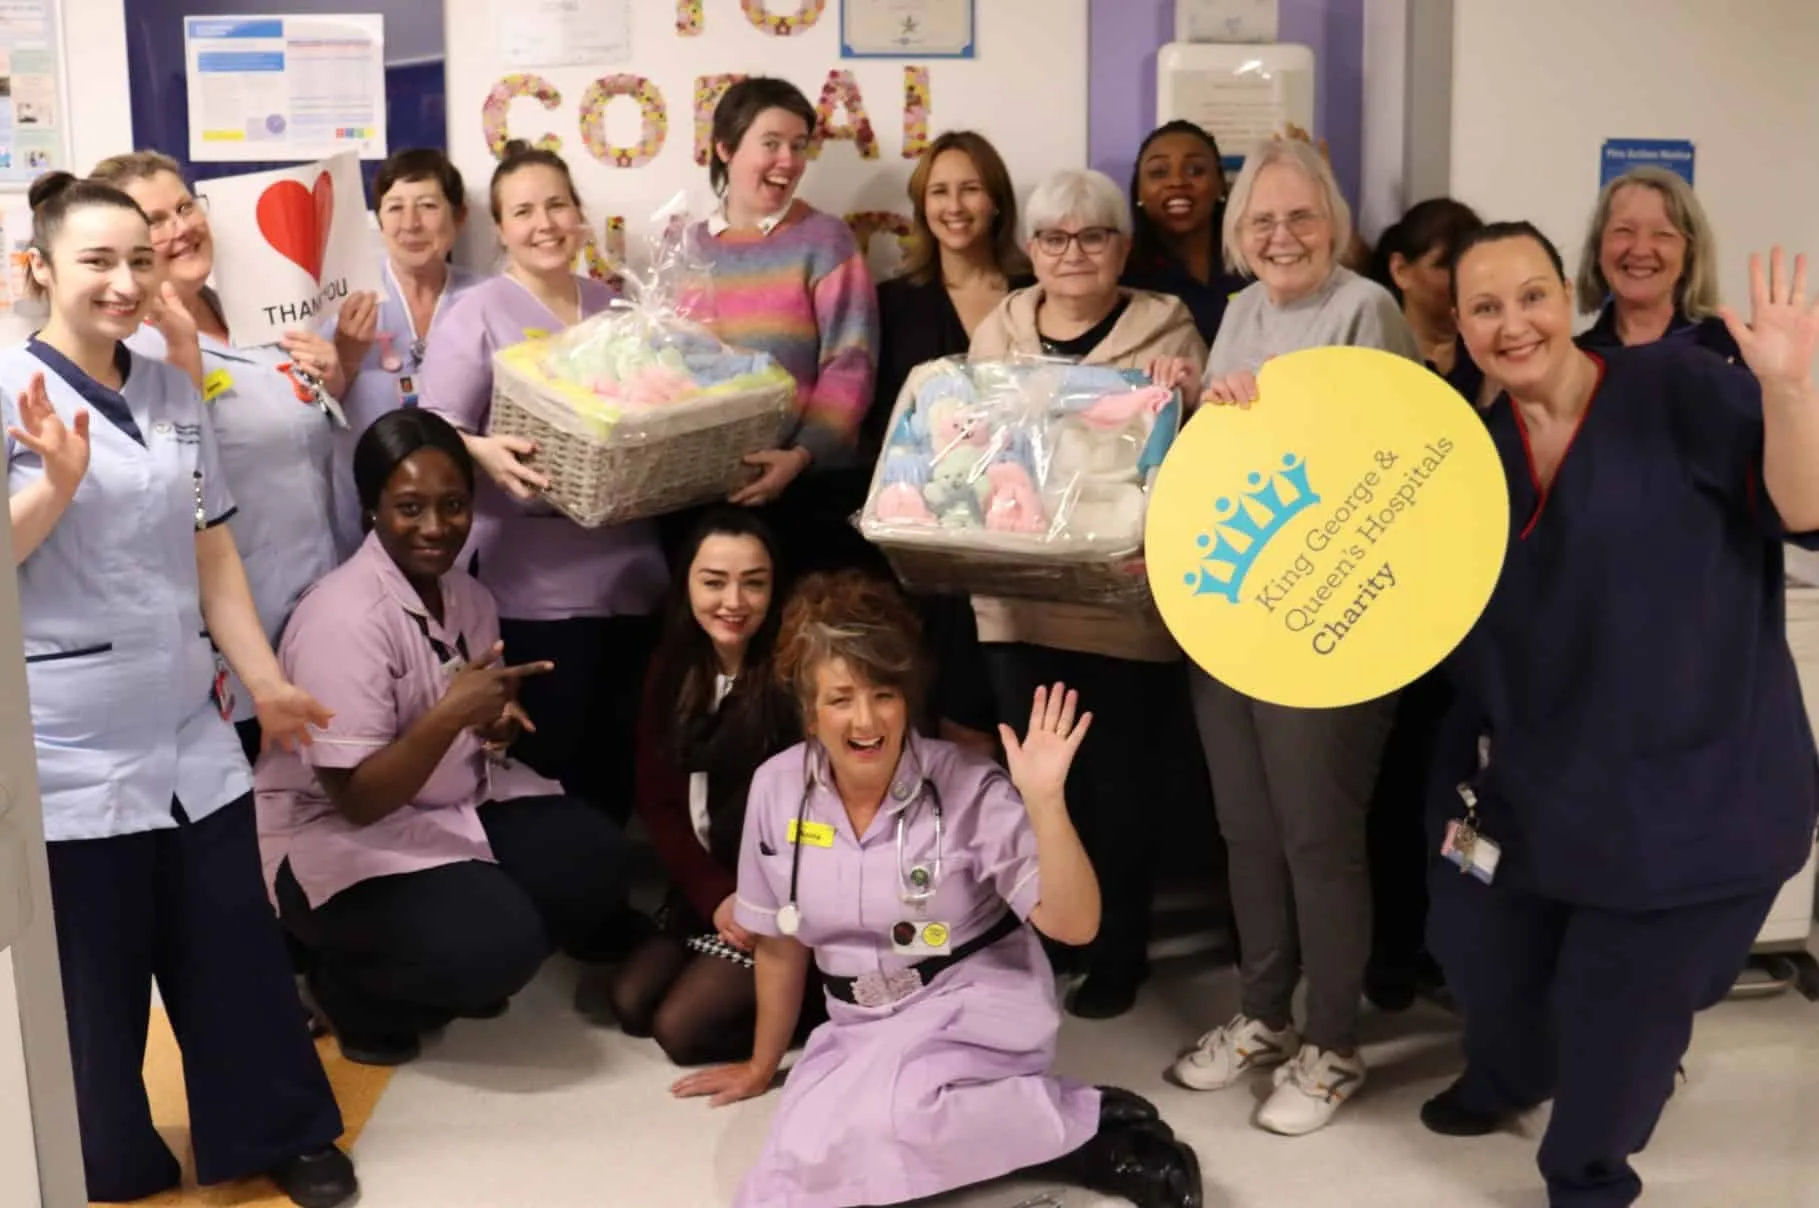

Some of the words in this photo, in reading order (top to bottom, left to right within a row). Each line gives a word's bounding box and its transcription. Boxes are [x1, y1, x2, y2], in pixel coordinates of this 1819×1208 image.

[1256, 556, 1314, 612] King
[1305, 471, 1381, 552] George
[1374, 449, 1399, 471] &
[1285, 544, 1366, 632] Queen's
[1356, 437, 1454, 544] Hospitals
[1312, 561, 1396, 655] Charity
